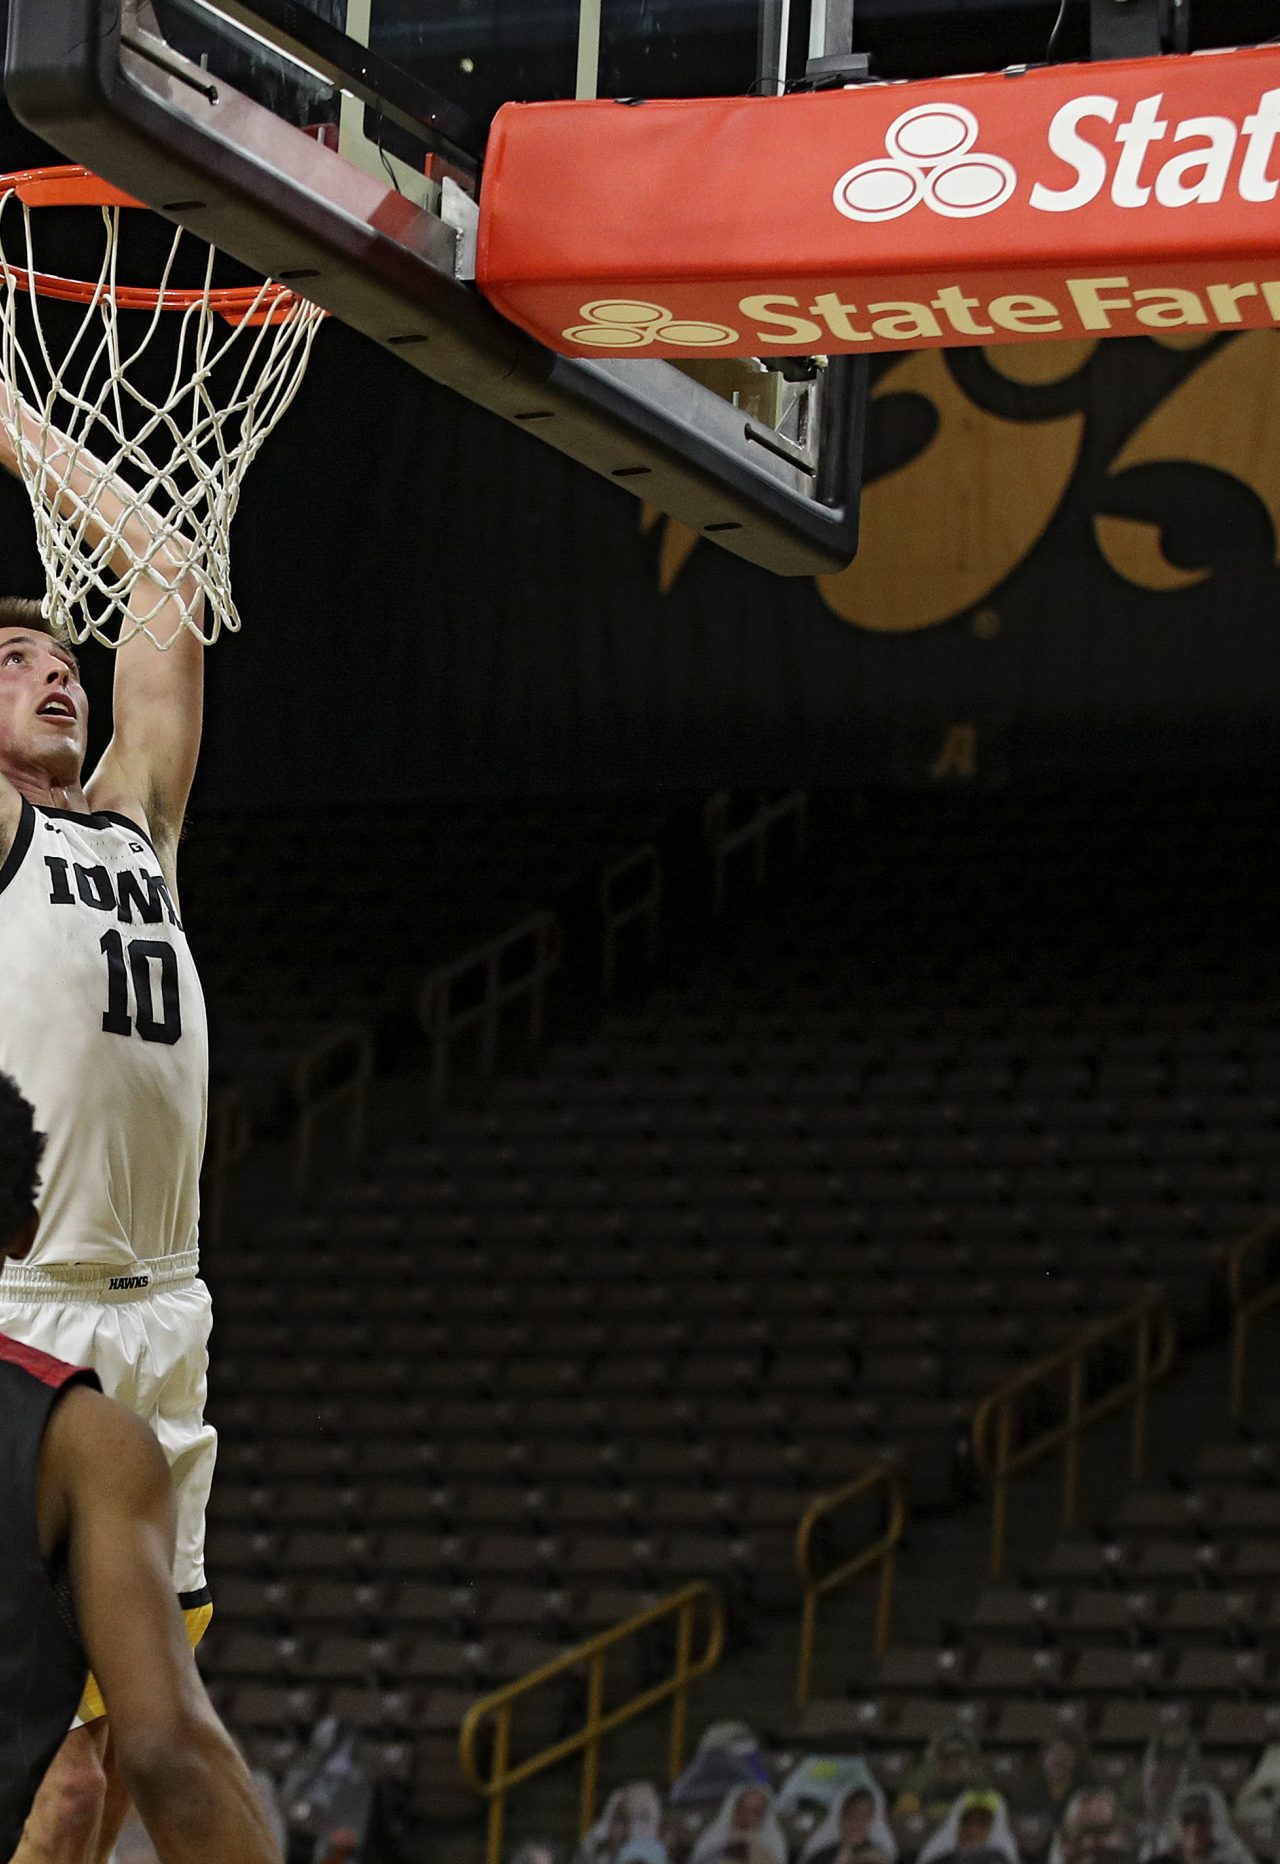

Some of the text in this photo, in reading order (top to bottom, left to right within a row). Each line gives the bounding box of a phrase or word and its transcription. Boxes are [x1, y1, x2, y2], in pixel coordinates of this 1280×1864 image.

[1065, 276, 1280, 331] Far
[100, 928, 183, 1046] 10
[108, 1275, 149, 1290] HAWKS
